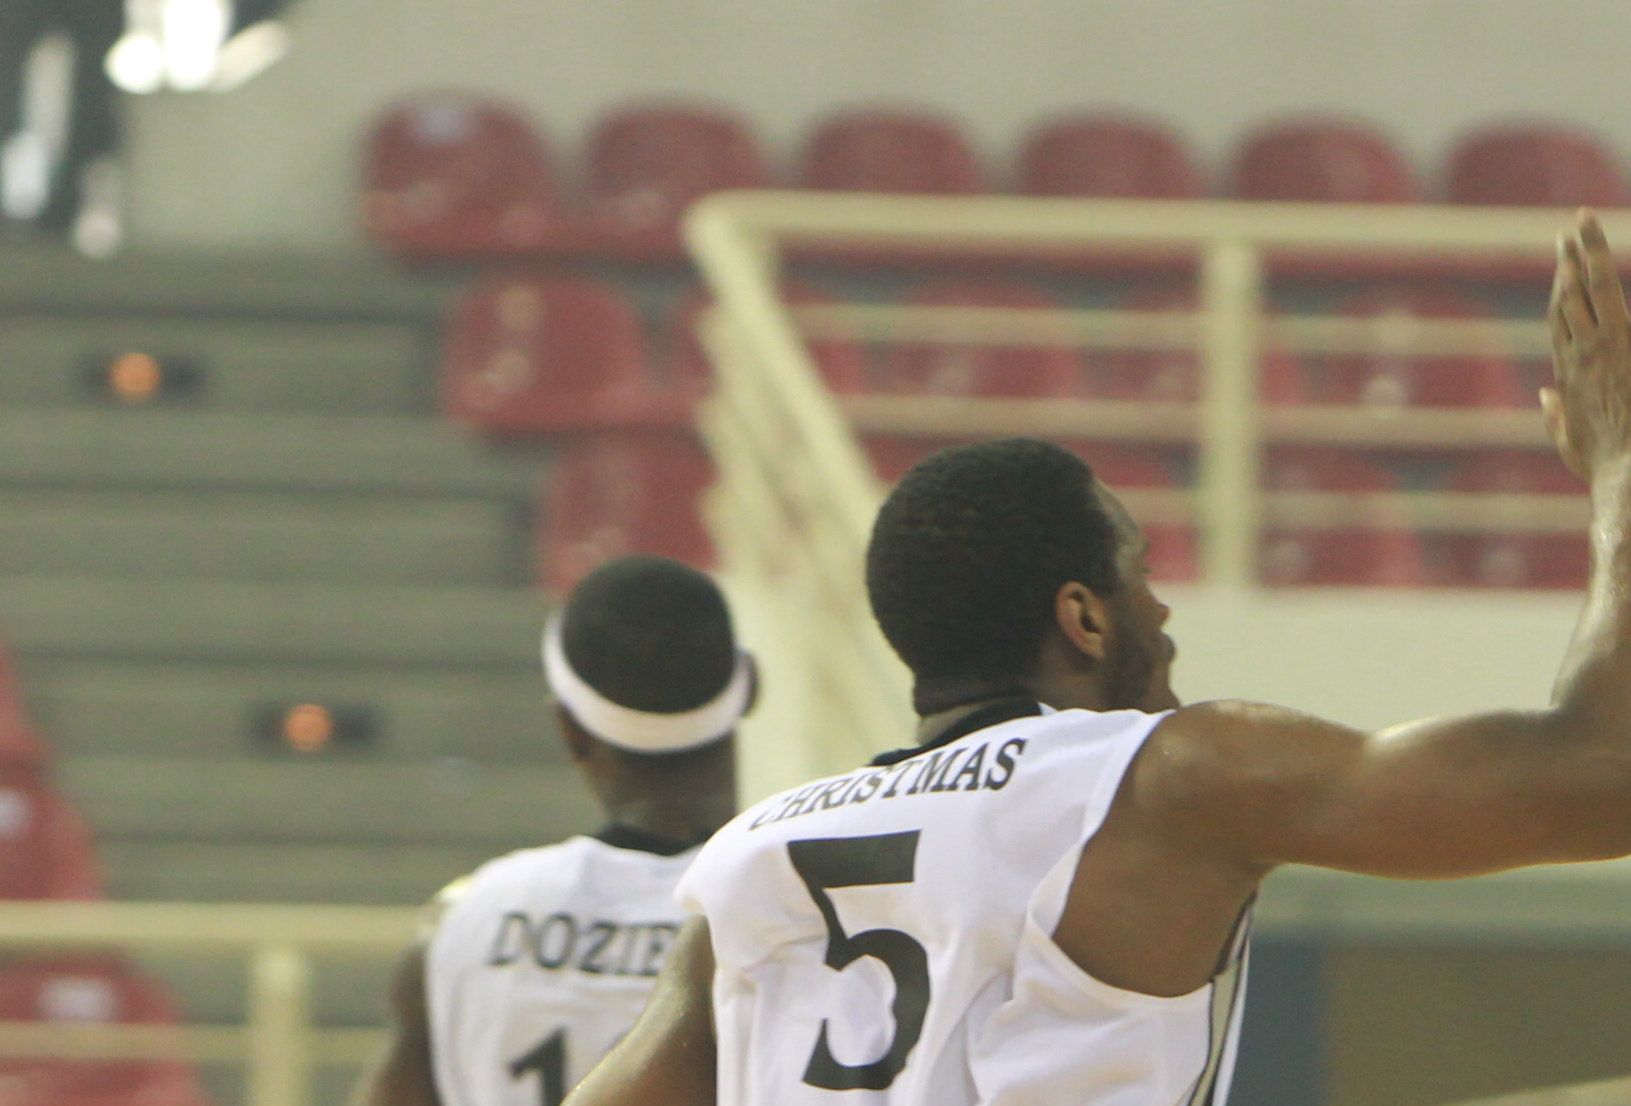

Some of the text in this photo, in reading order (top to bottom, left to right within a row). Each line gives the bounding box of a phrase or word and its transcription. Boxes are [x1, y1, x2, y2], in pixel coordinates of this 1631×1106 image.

[748, 738, 1029, 831] CHRISTMAS
[487, 911, 682, 978] DOZIE
[787, 828, 931, 1091] 5
